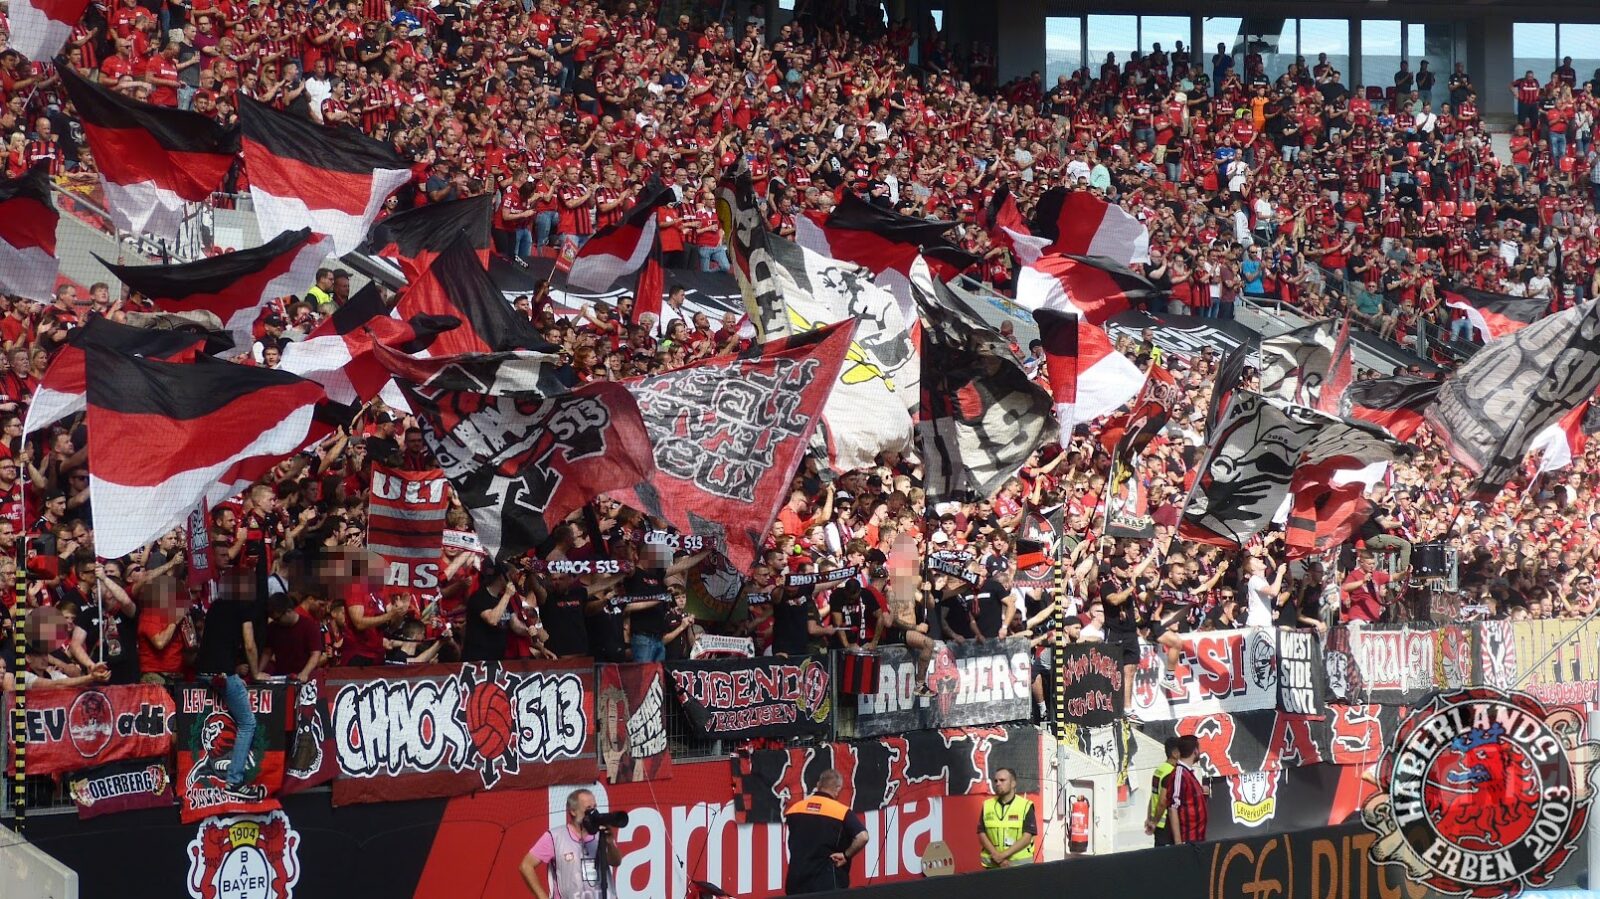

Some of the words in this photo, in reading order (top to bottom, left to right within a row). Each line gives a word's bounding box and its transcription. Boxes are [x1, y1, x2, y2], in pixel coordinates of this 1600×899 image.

[372, 471, 449, 504] ULT
[684, 535, 703, 549] 513
[386, 560, 440, 588] AS
[547, 560, 591, 574] CHAOS
[595, 560, 620, 573] 513
[1280, 630, 1313, 661] WEST
[671, 665, 803, 709] JUGEND
[1280, 659, 1314, 690] SIDE
[1283, 687, 1318, 715] BOYZ
[332, 673, 471, 778] CHAOS
[515, 671, 587, 763] 513
[88, 771, 152, 800] OBERBERG
[1236, 802, 1272, 820] Leverkusen
[231, 826, 260, 843] 1904
[223, 876, 267, 893] BAYER
